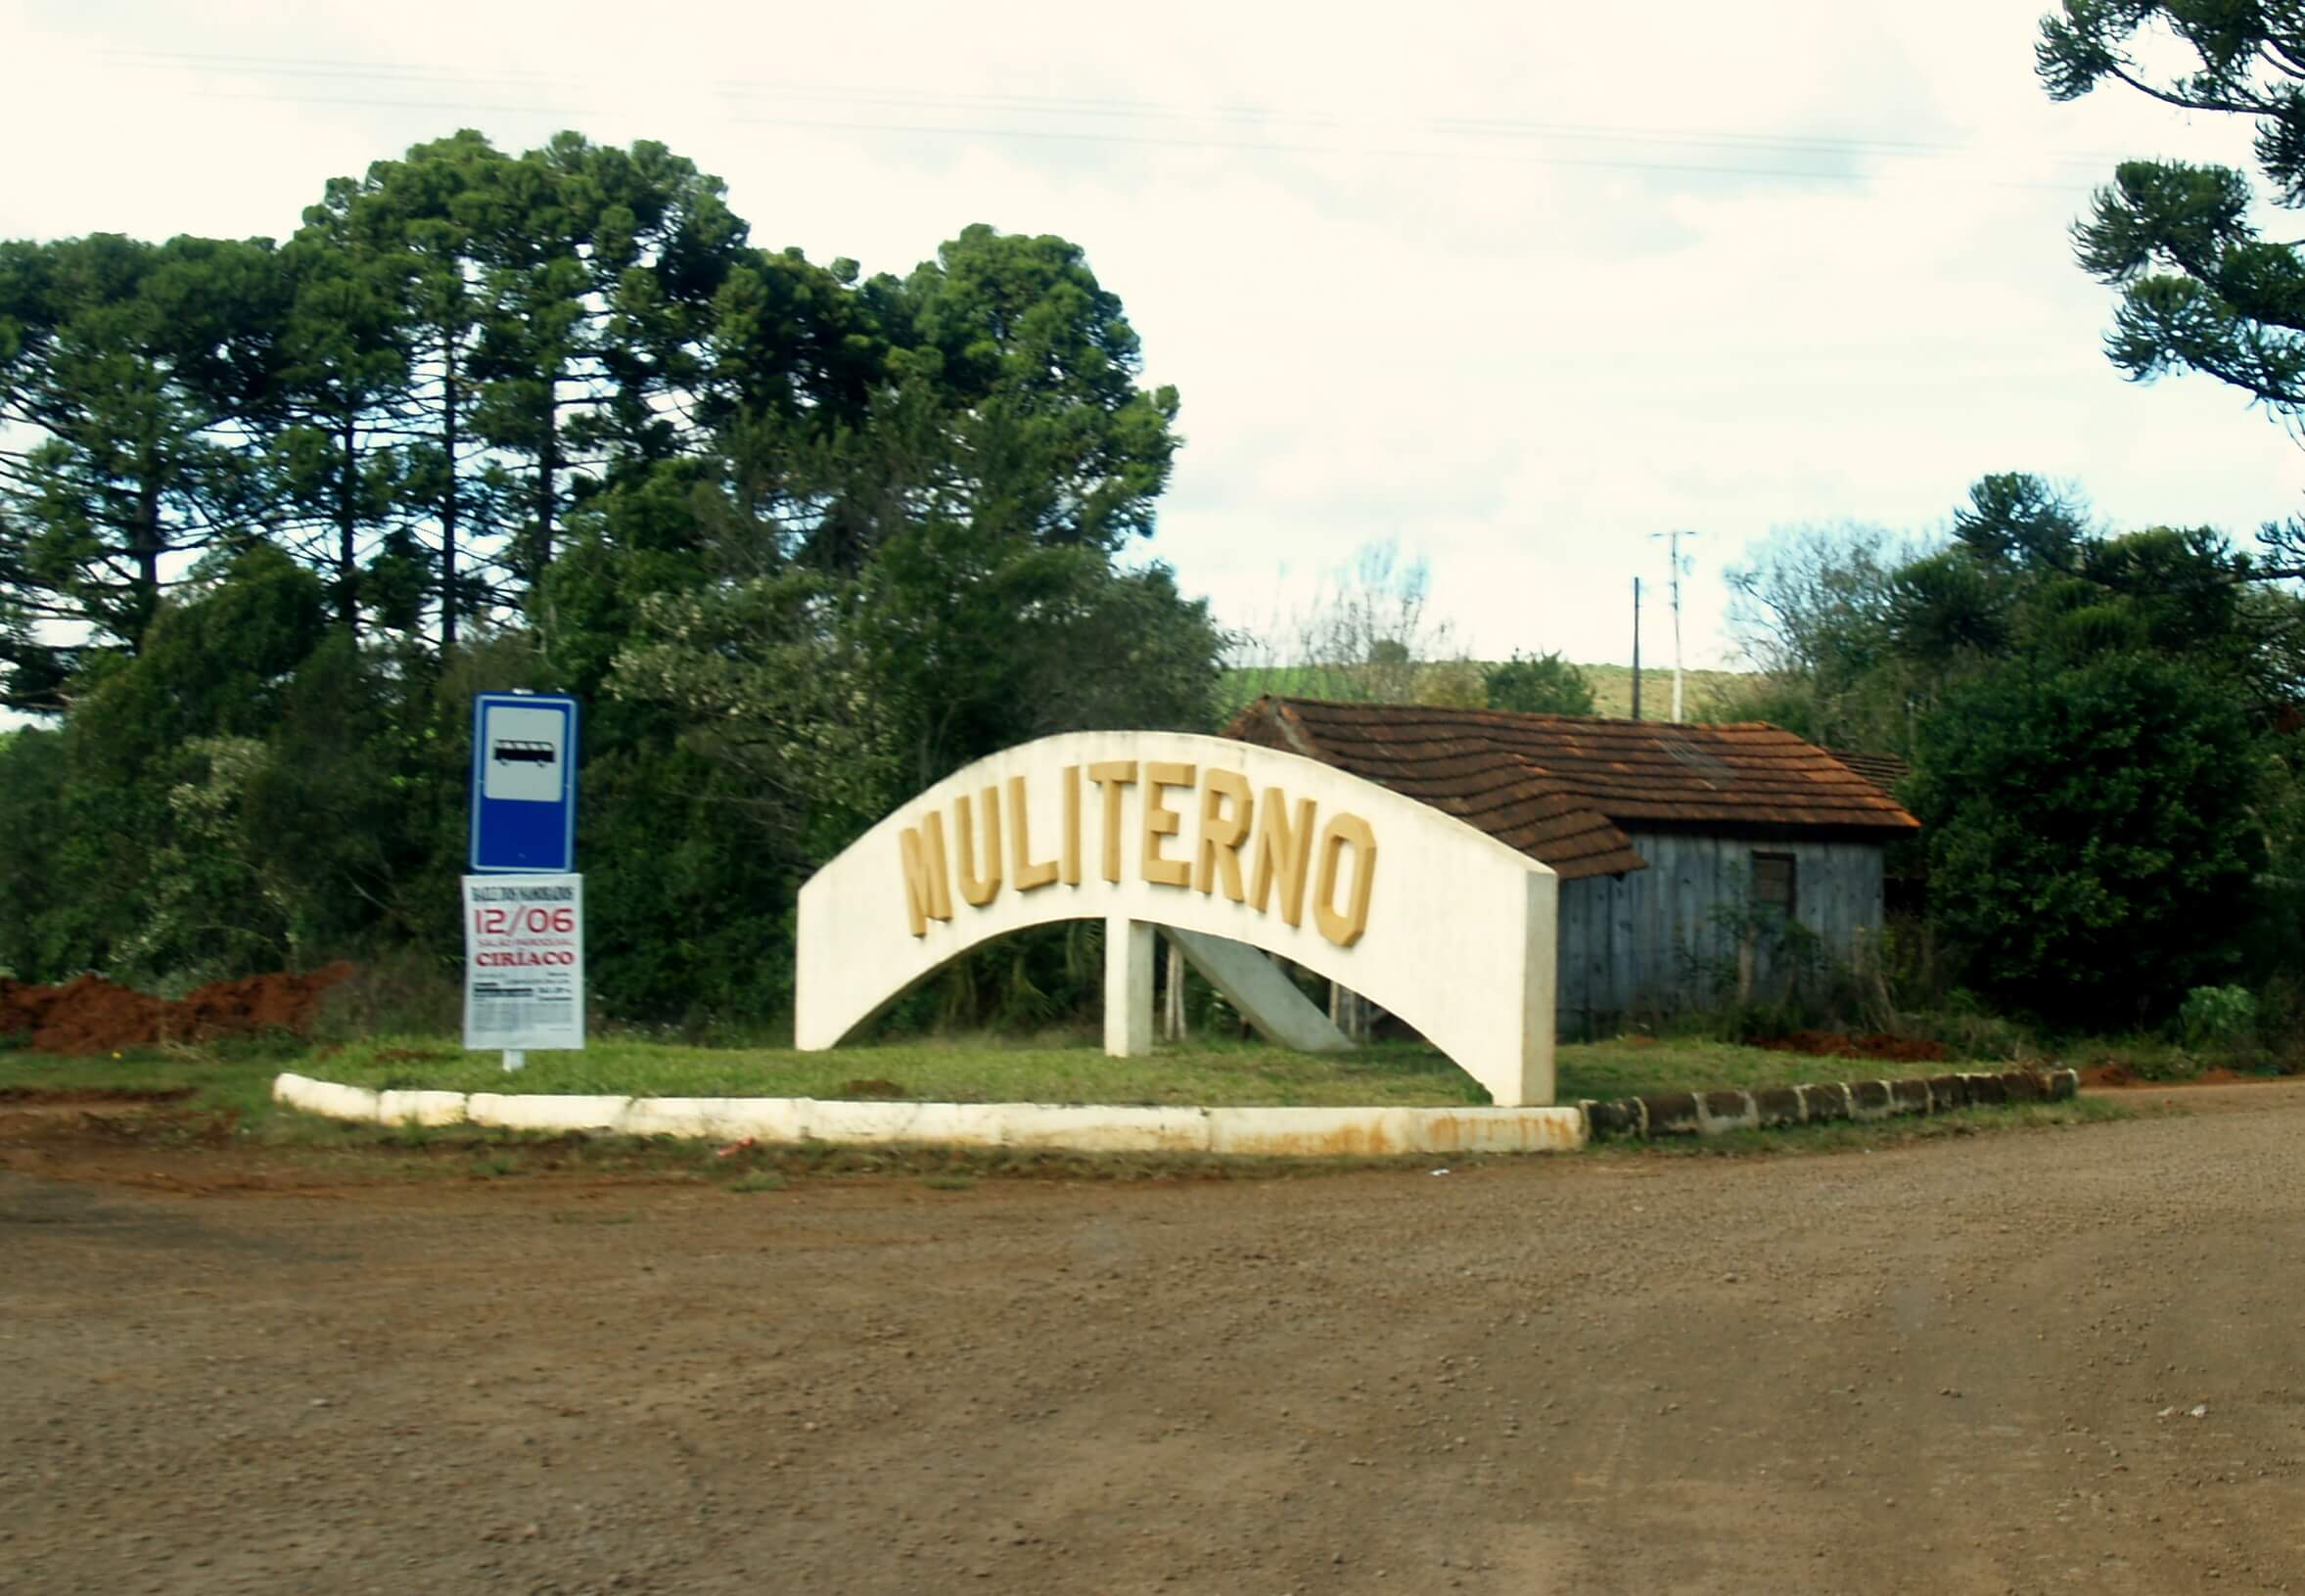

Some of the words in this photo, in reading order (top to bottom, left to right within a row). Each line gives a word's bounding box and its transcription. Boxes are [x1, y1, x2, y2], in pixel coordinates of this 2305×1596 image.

[899, 760, 1376, 947] MULITERNO
[475, 905, 575, 936] 12/06
[476, 947, 575, 967] CIRÍACO
